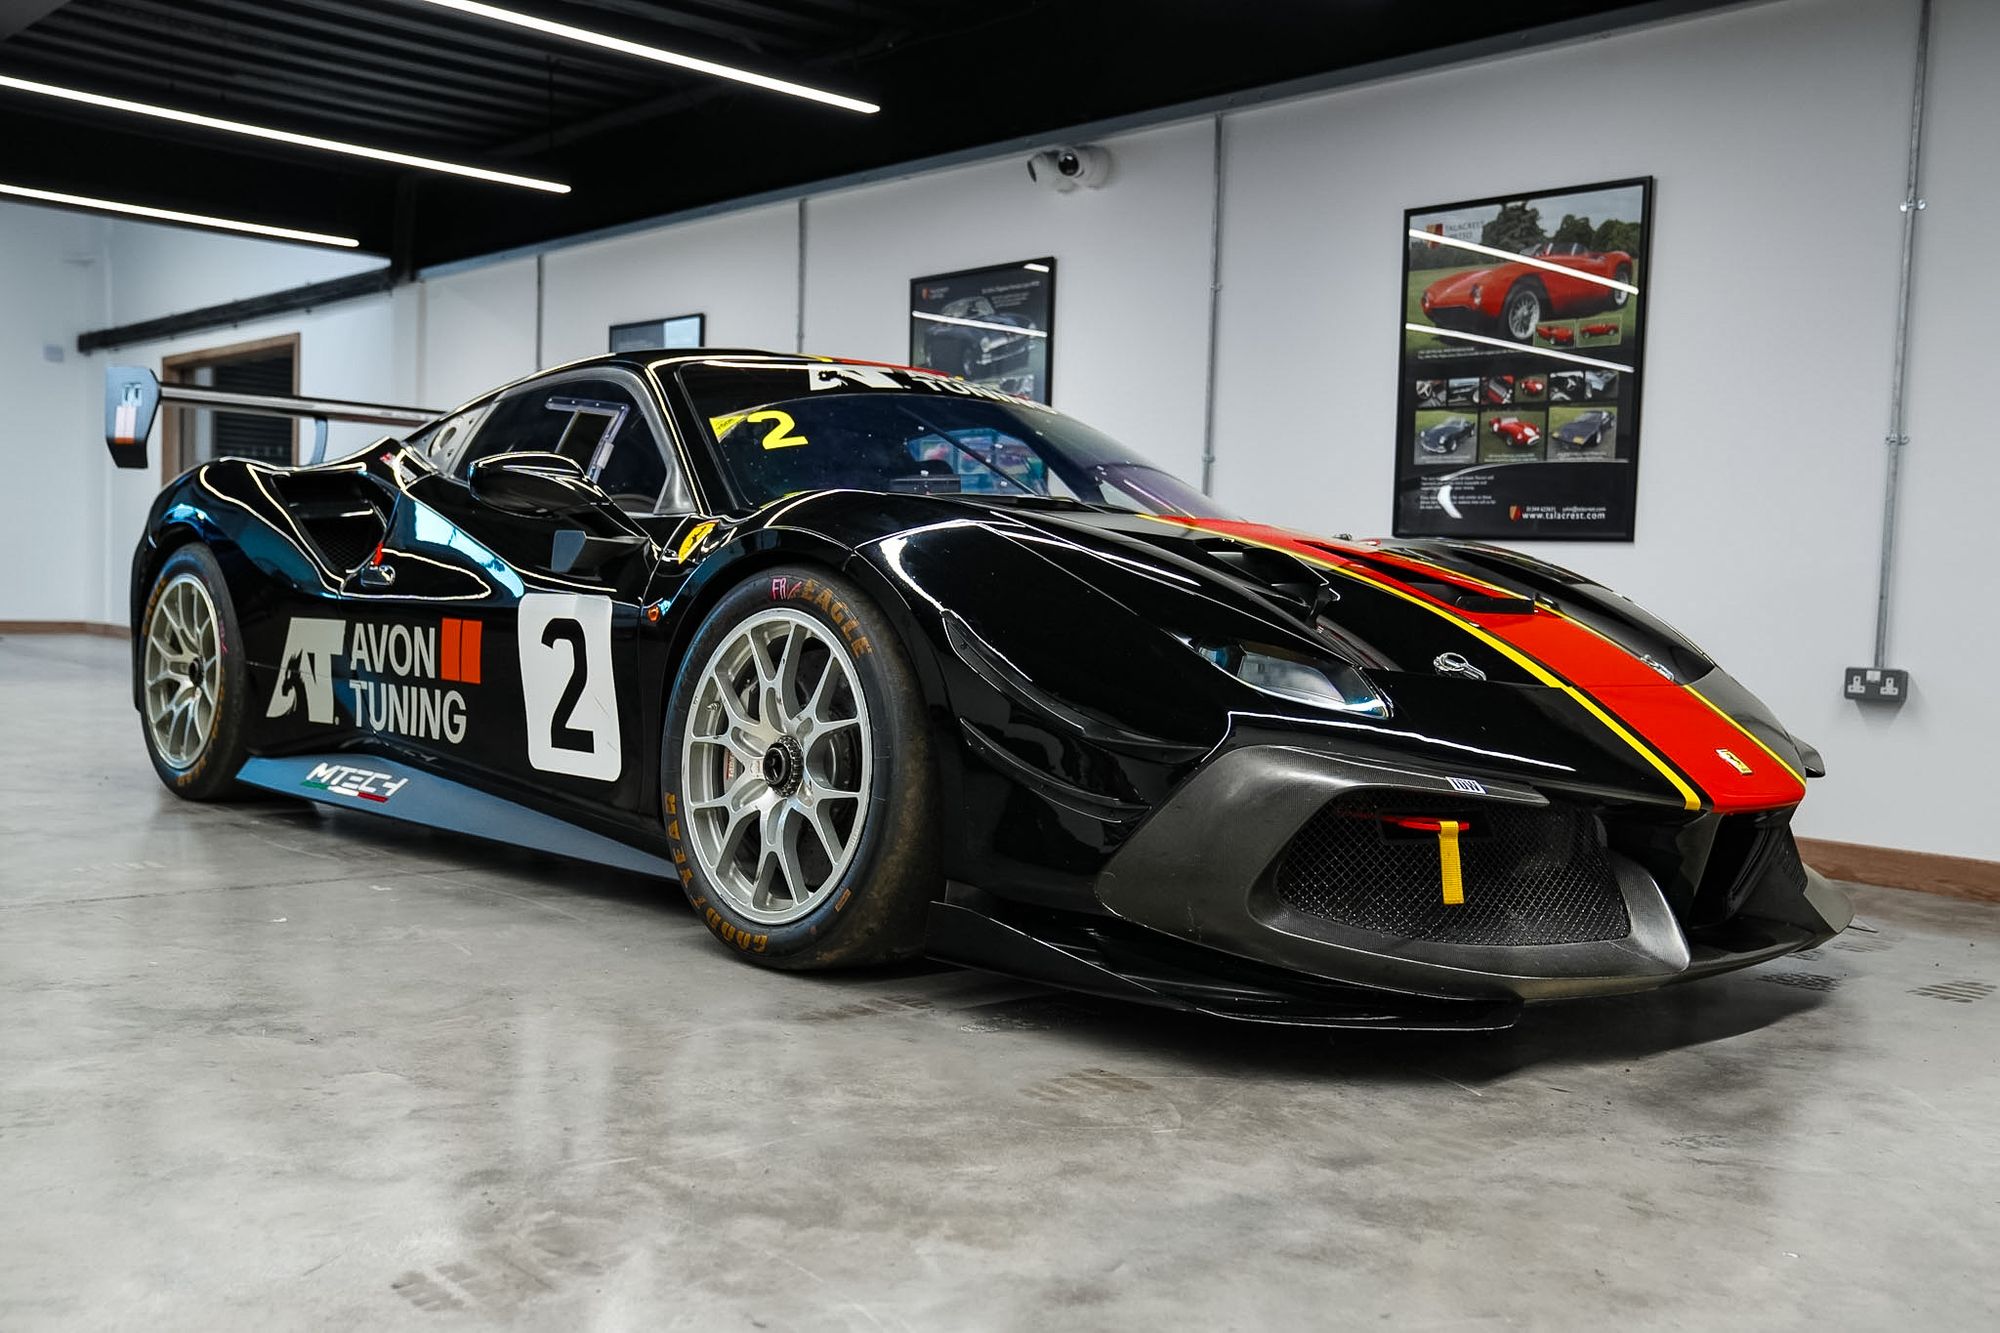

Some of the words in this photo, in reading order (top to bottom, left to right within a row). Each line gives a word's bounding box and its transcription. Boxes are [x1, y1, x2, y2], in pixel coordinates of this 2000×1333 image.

[747, 410, 808, 449] 2
[1522, 511, 1605, 520] www.talacrest.com
[800, 577, 873, 659] EAGLE
[350, 622, 436, 679] AVON
[349, 679, 467, 744] TUNING
[541, 617, 595, 753] 2
[305, 762, 409, 797] MTECH
[1450, 778, 1481, 792] TOW
[664, 791, 769, 953] GOODYEAR
